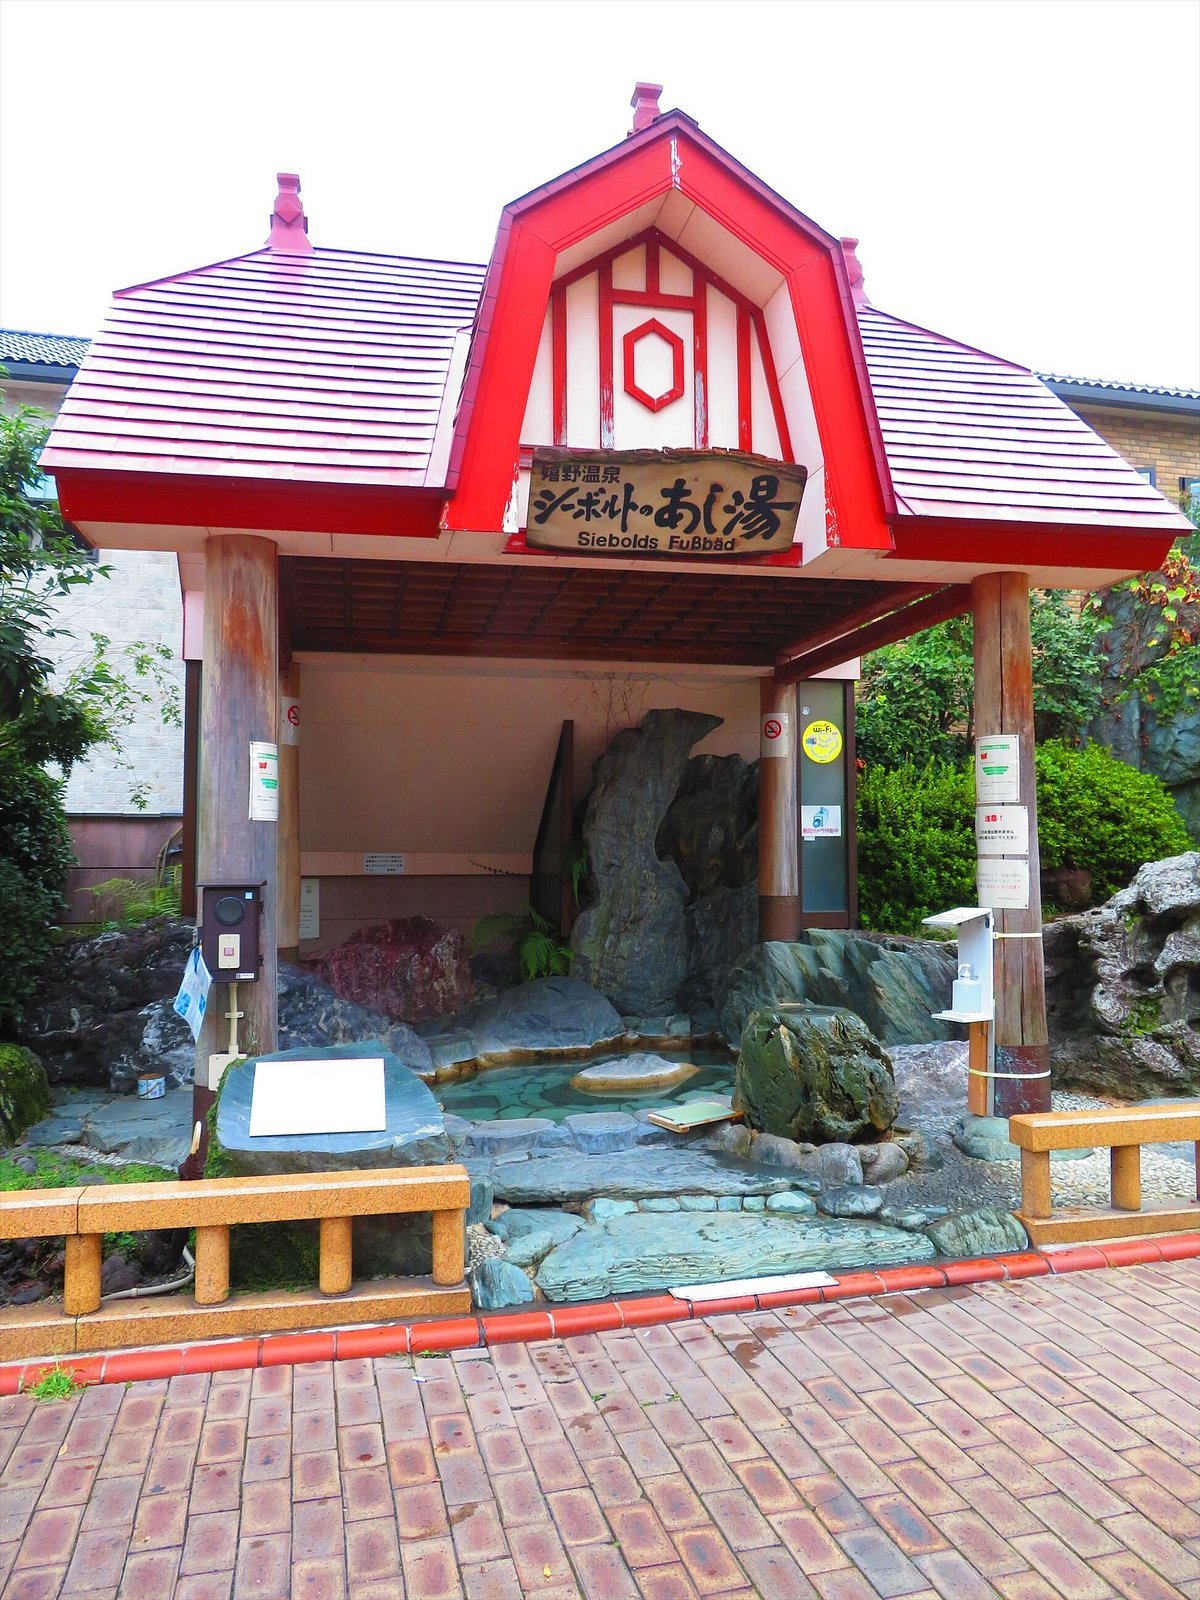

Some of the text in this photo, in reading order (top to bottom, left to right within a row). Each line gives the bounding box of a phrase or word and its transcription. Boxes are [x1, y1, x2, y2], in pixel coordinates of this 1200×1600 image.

[541, 466, 621, 484] 嬉野温泉
[533, 475, 798, 540] シーボルトのあし湯
[577, 531, 659, 549] Siebolds
